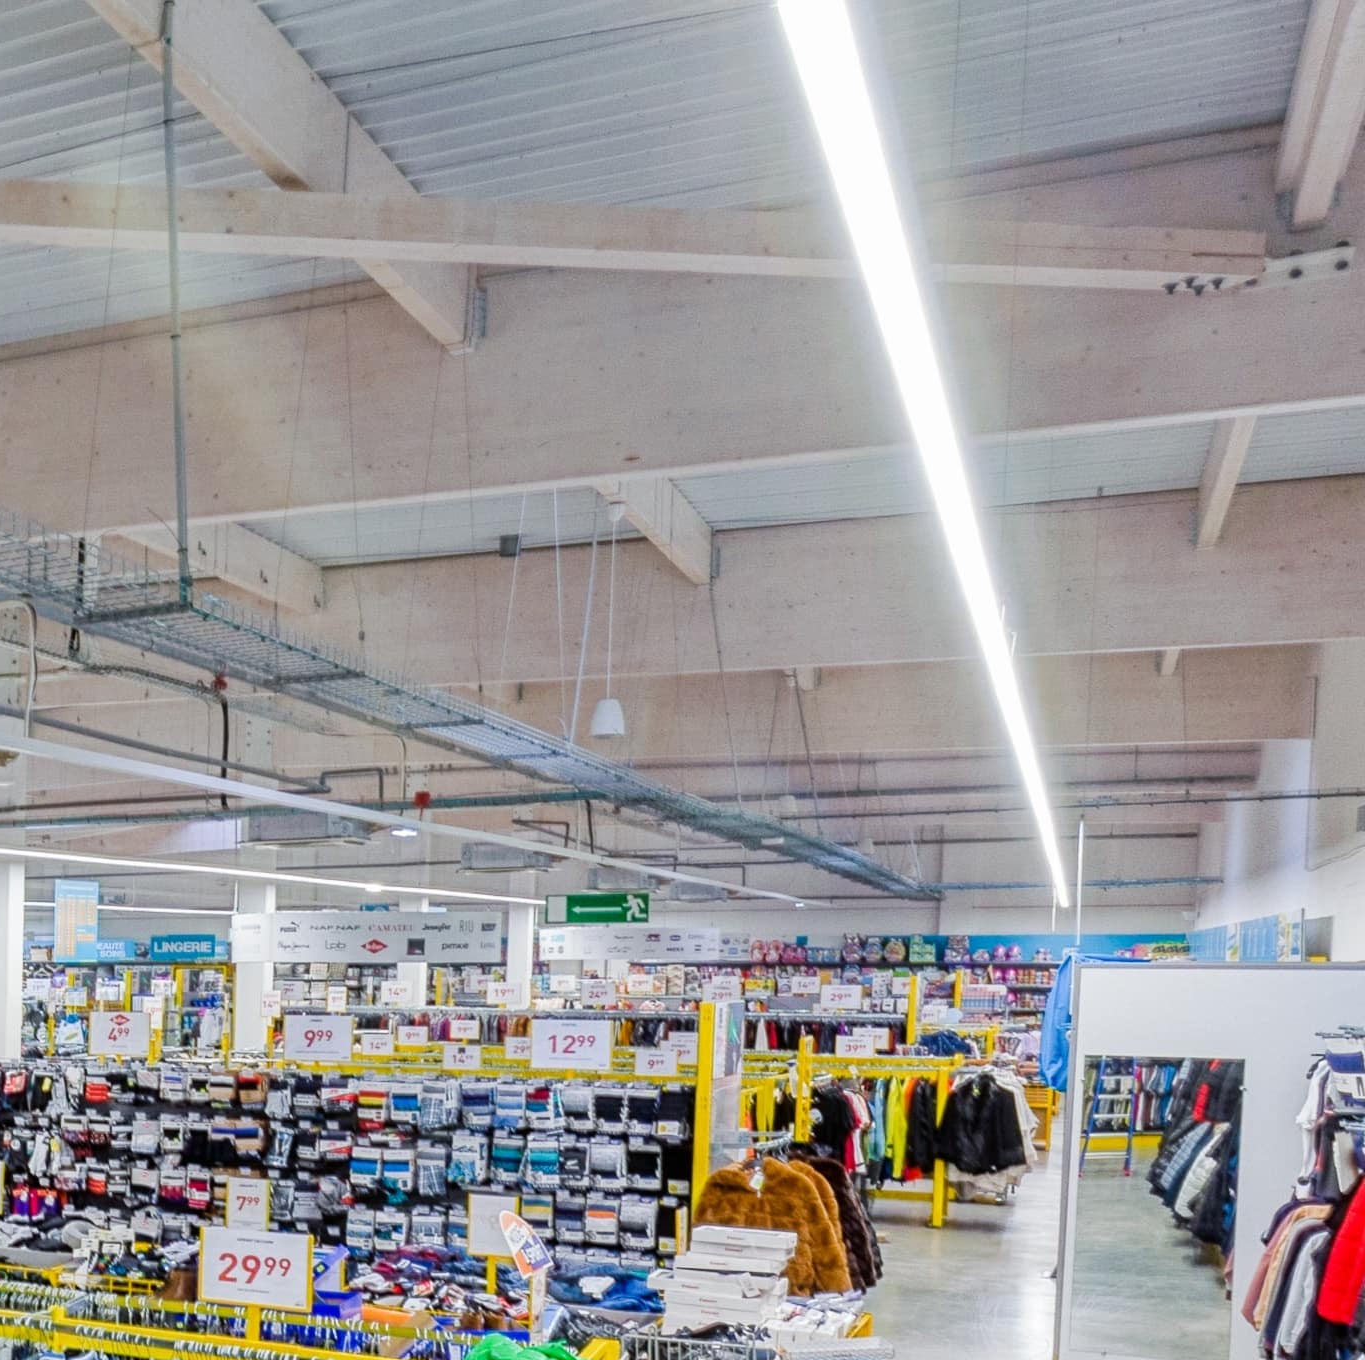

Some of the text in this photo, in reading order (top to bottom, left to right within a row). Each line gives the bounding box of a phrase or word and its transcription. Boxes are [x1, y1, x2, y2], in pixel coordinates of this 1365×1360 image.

[154, 941, 212, 953] LINGERIE
[108, 1027, 129, 1042] 499
[304, 1030, 333, 1048] 999
[548, 1034, 596, 1054] 1299
[236, 1196, 260, 1211] 799
[218, 1252, 291, 1284] 2999
